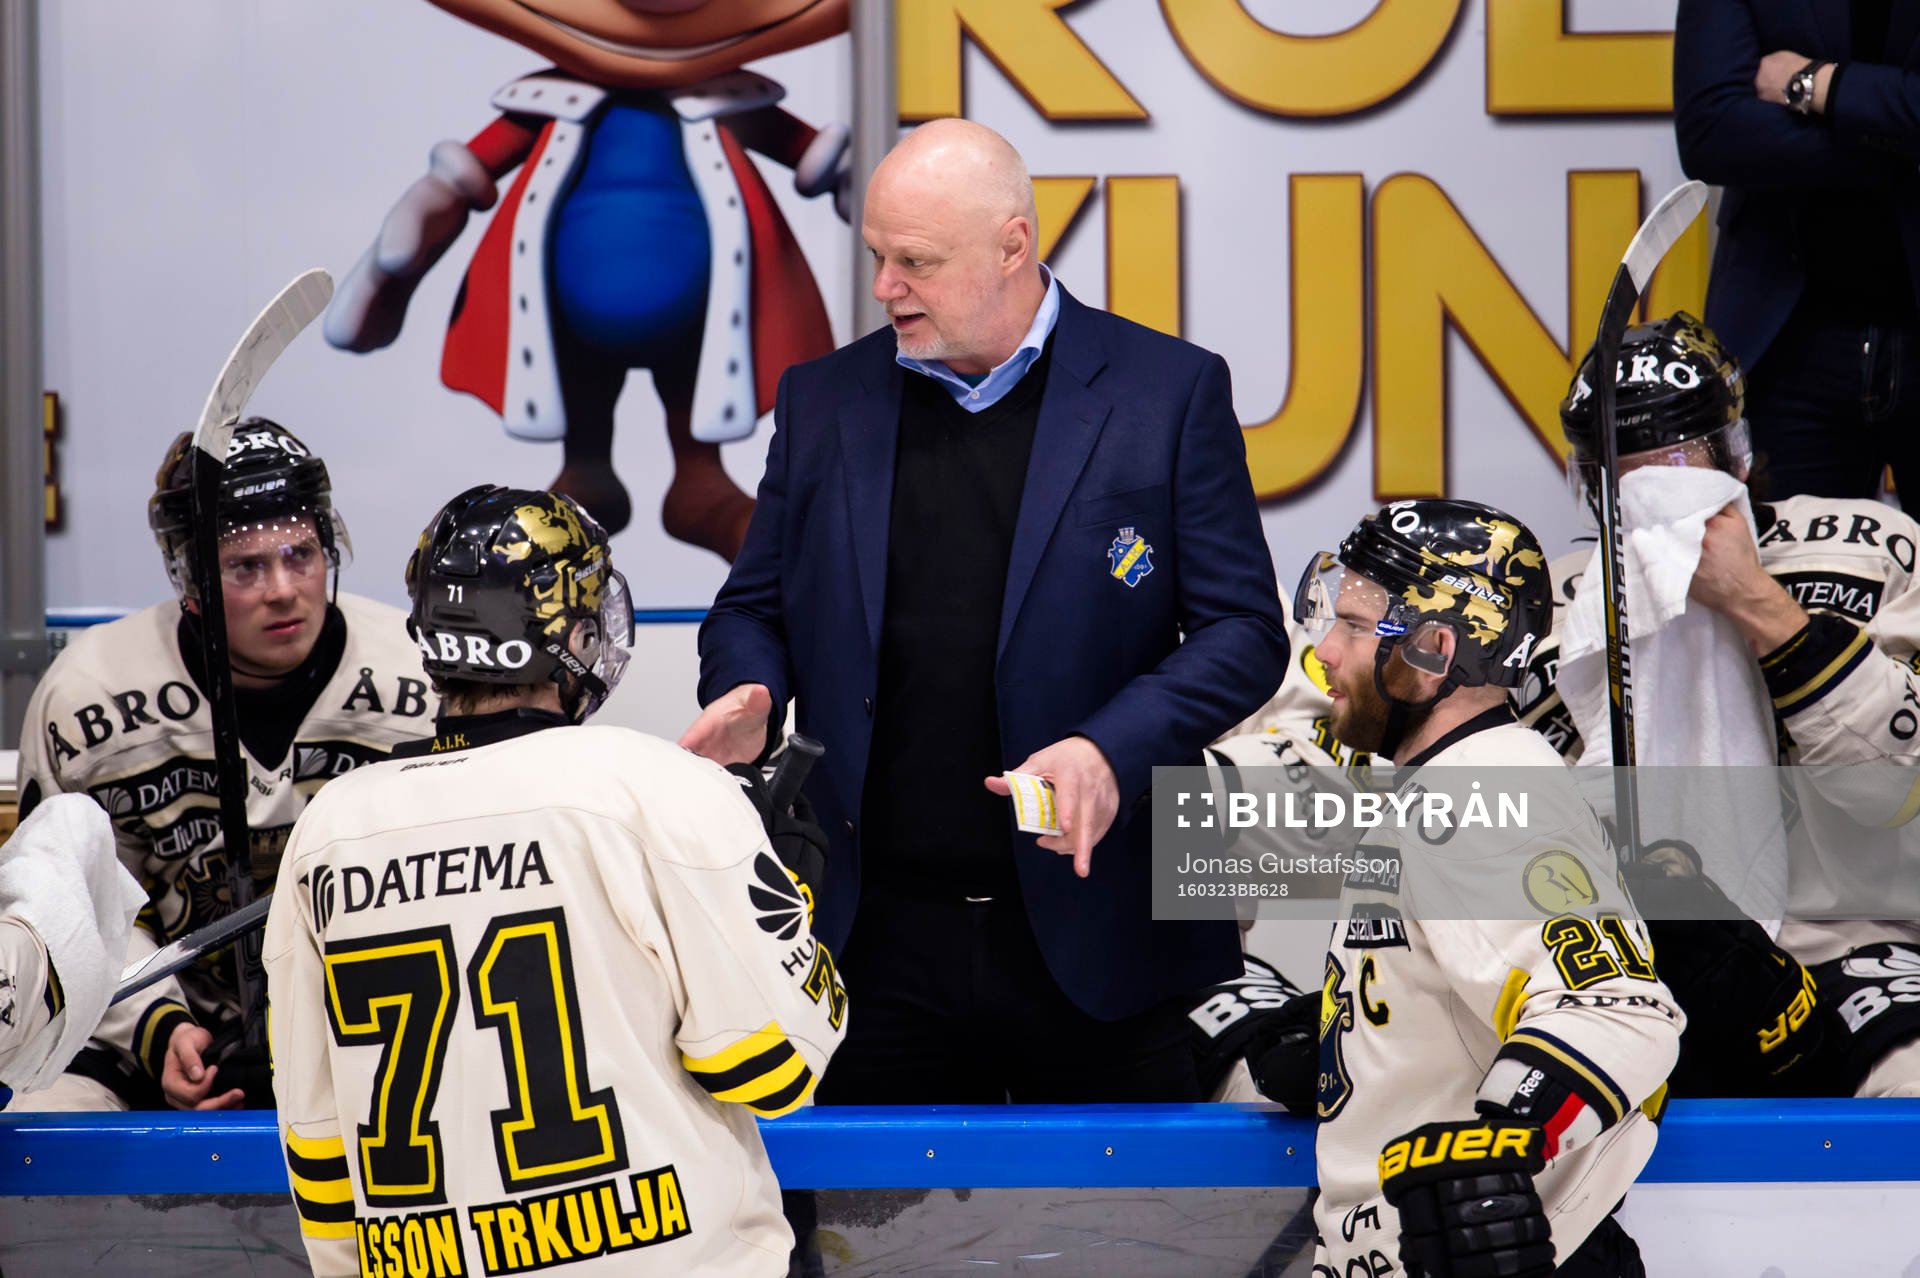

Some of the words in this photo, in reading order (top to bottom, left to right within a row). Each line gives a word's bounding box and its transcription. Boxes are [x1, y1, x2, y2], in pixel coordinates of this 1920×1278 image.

[226, 431, 307, 457] BRO
[447, 584, 462, 603] 71
[1440, 574, 1505, 606] BAUER
[48, 681, 199, 770] ÅBRO
[431, 733, 470, 752] A.I.K.
[137, 768, 218, 811] DATEM
[341, 840, 554, 914] DATEMA
[780, 938, 816, 977] HU
[1541, 912, 1658, 990] 21
[1359, 952, 1391, 1028] C
[325, 906, 629, 1206] 71
[1377, 1126, 1532, 1190] AUER
[469, 1166, 692, 1275] TRKULJA
